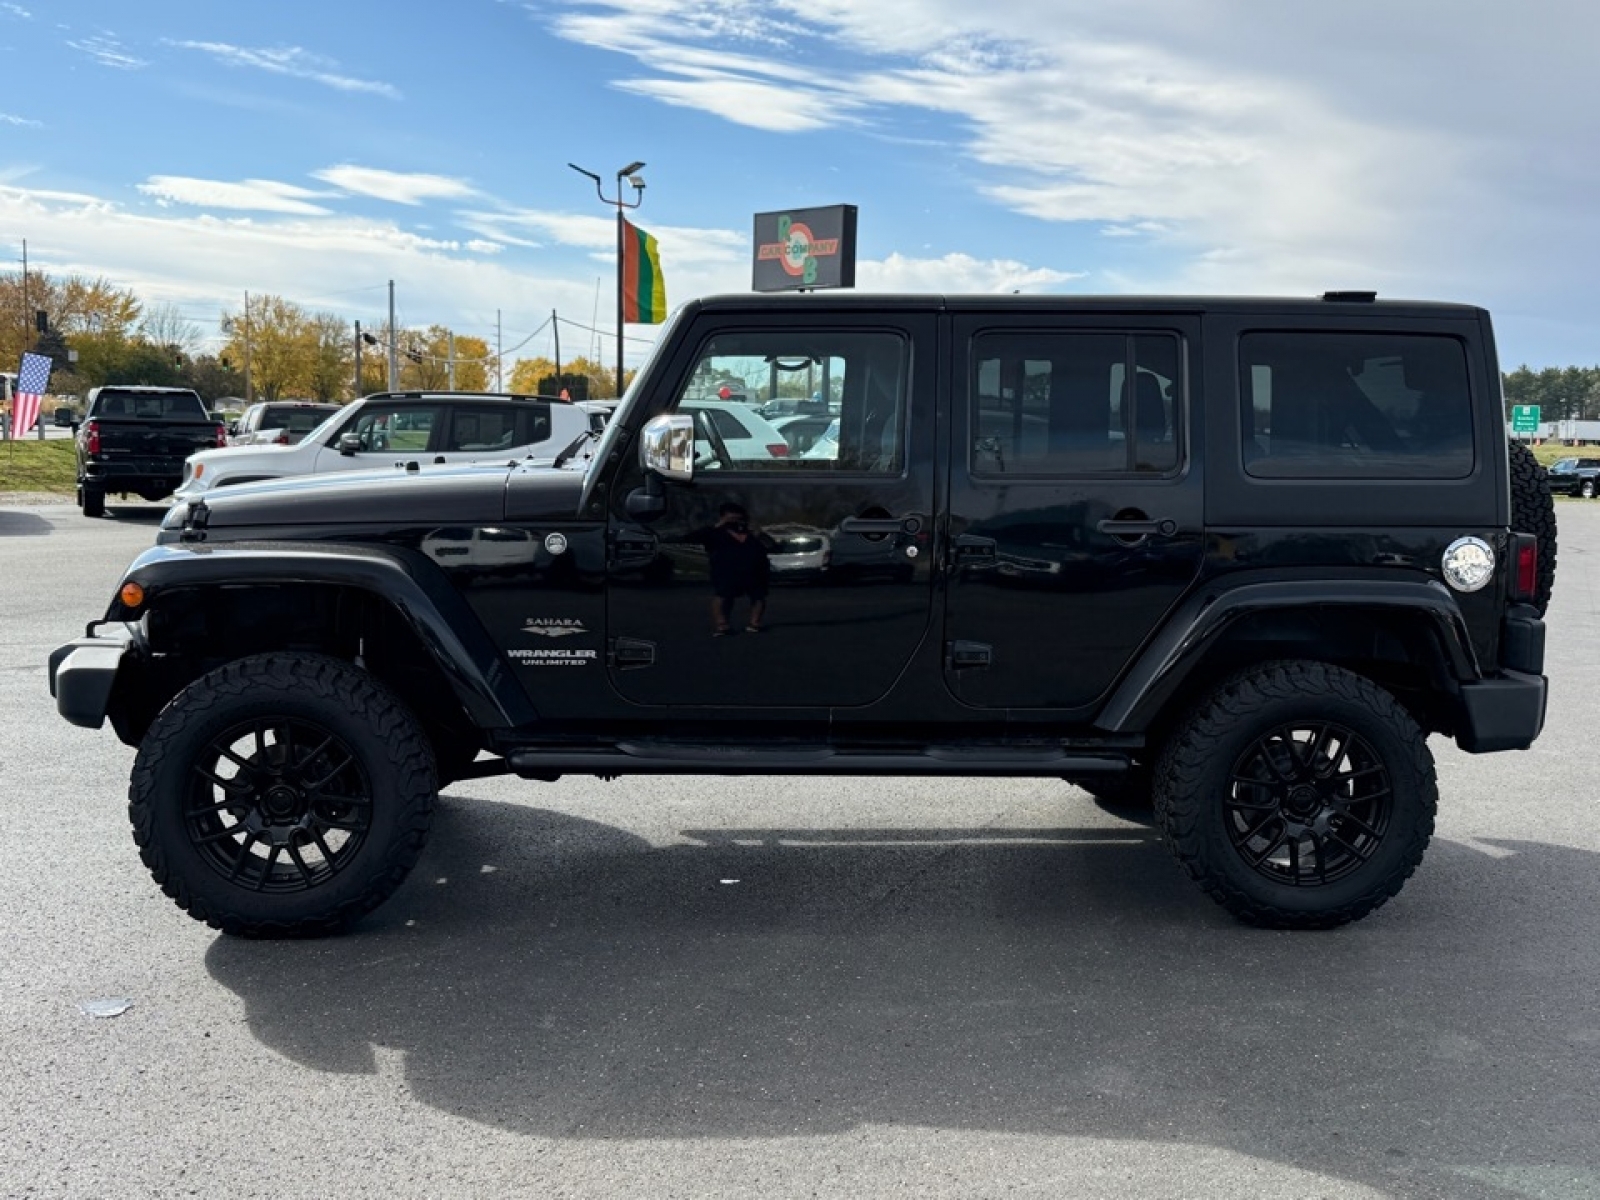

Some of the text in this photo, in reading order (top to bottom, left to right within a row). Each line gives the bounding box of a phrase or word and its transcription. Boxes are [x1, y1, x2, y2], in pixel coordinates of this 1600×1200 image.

[784, 242, 835, 256] COMPANY
[526, 618, 583, 626] SAHARA
[507, 649, 597, 658] WRANGLER
